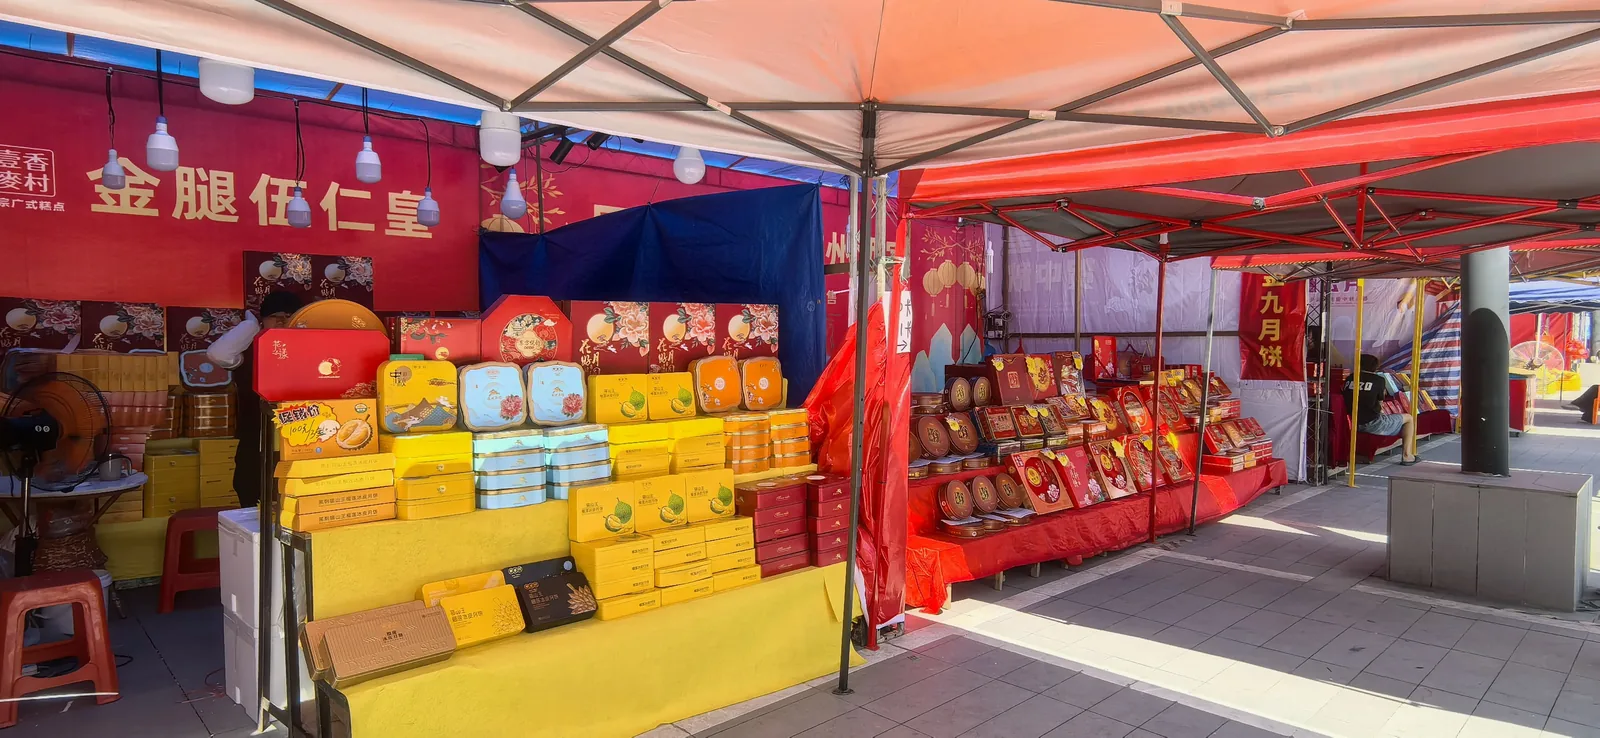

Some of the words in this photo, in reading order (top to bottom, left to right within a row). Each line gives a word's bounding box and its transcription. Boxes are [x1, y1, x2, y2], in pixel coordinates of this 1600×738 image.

[86, 156, 434, 240] 金腿伍仁皇
